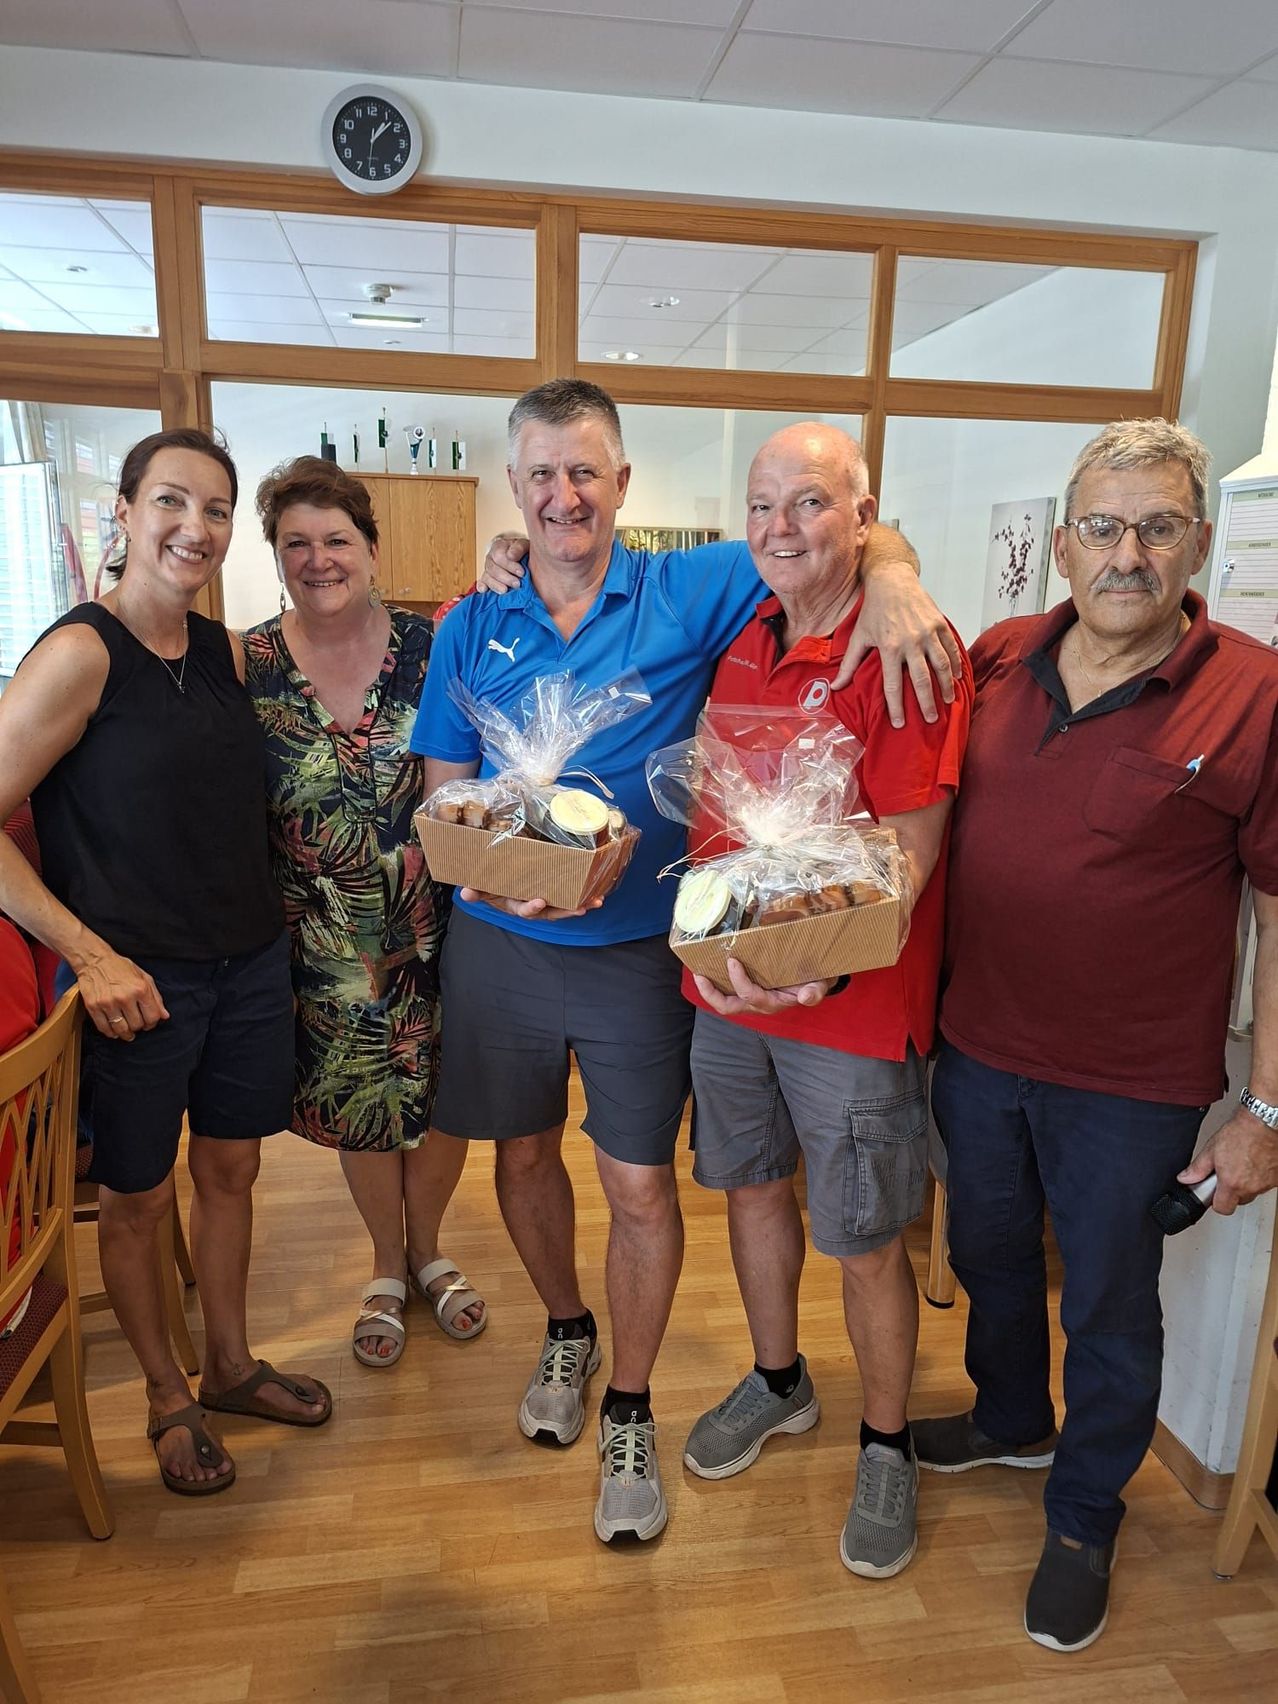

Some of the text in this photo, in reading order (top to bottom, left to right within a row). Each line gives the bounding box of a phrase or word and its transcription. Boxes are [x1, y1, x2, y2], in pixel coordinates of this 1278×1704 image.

[355, 108, 362, 118] 11
[367, 106, 377, 116] 12
[384, 111, 388, 120] 1
[344, 119, 354, 130] 10
[393, 123, 400, 132] 2
[340, 133, 347, 143] 9
[399, 139, 406, 149] 3
[344, 148, 352, 158] 8
[394, 153, 401, 163] 4
[356, 160, 363, 170] 7
[383, 164, 391, 174] 5
[369, 167, 376, 177] 6
